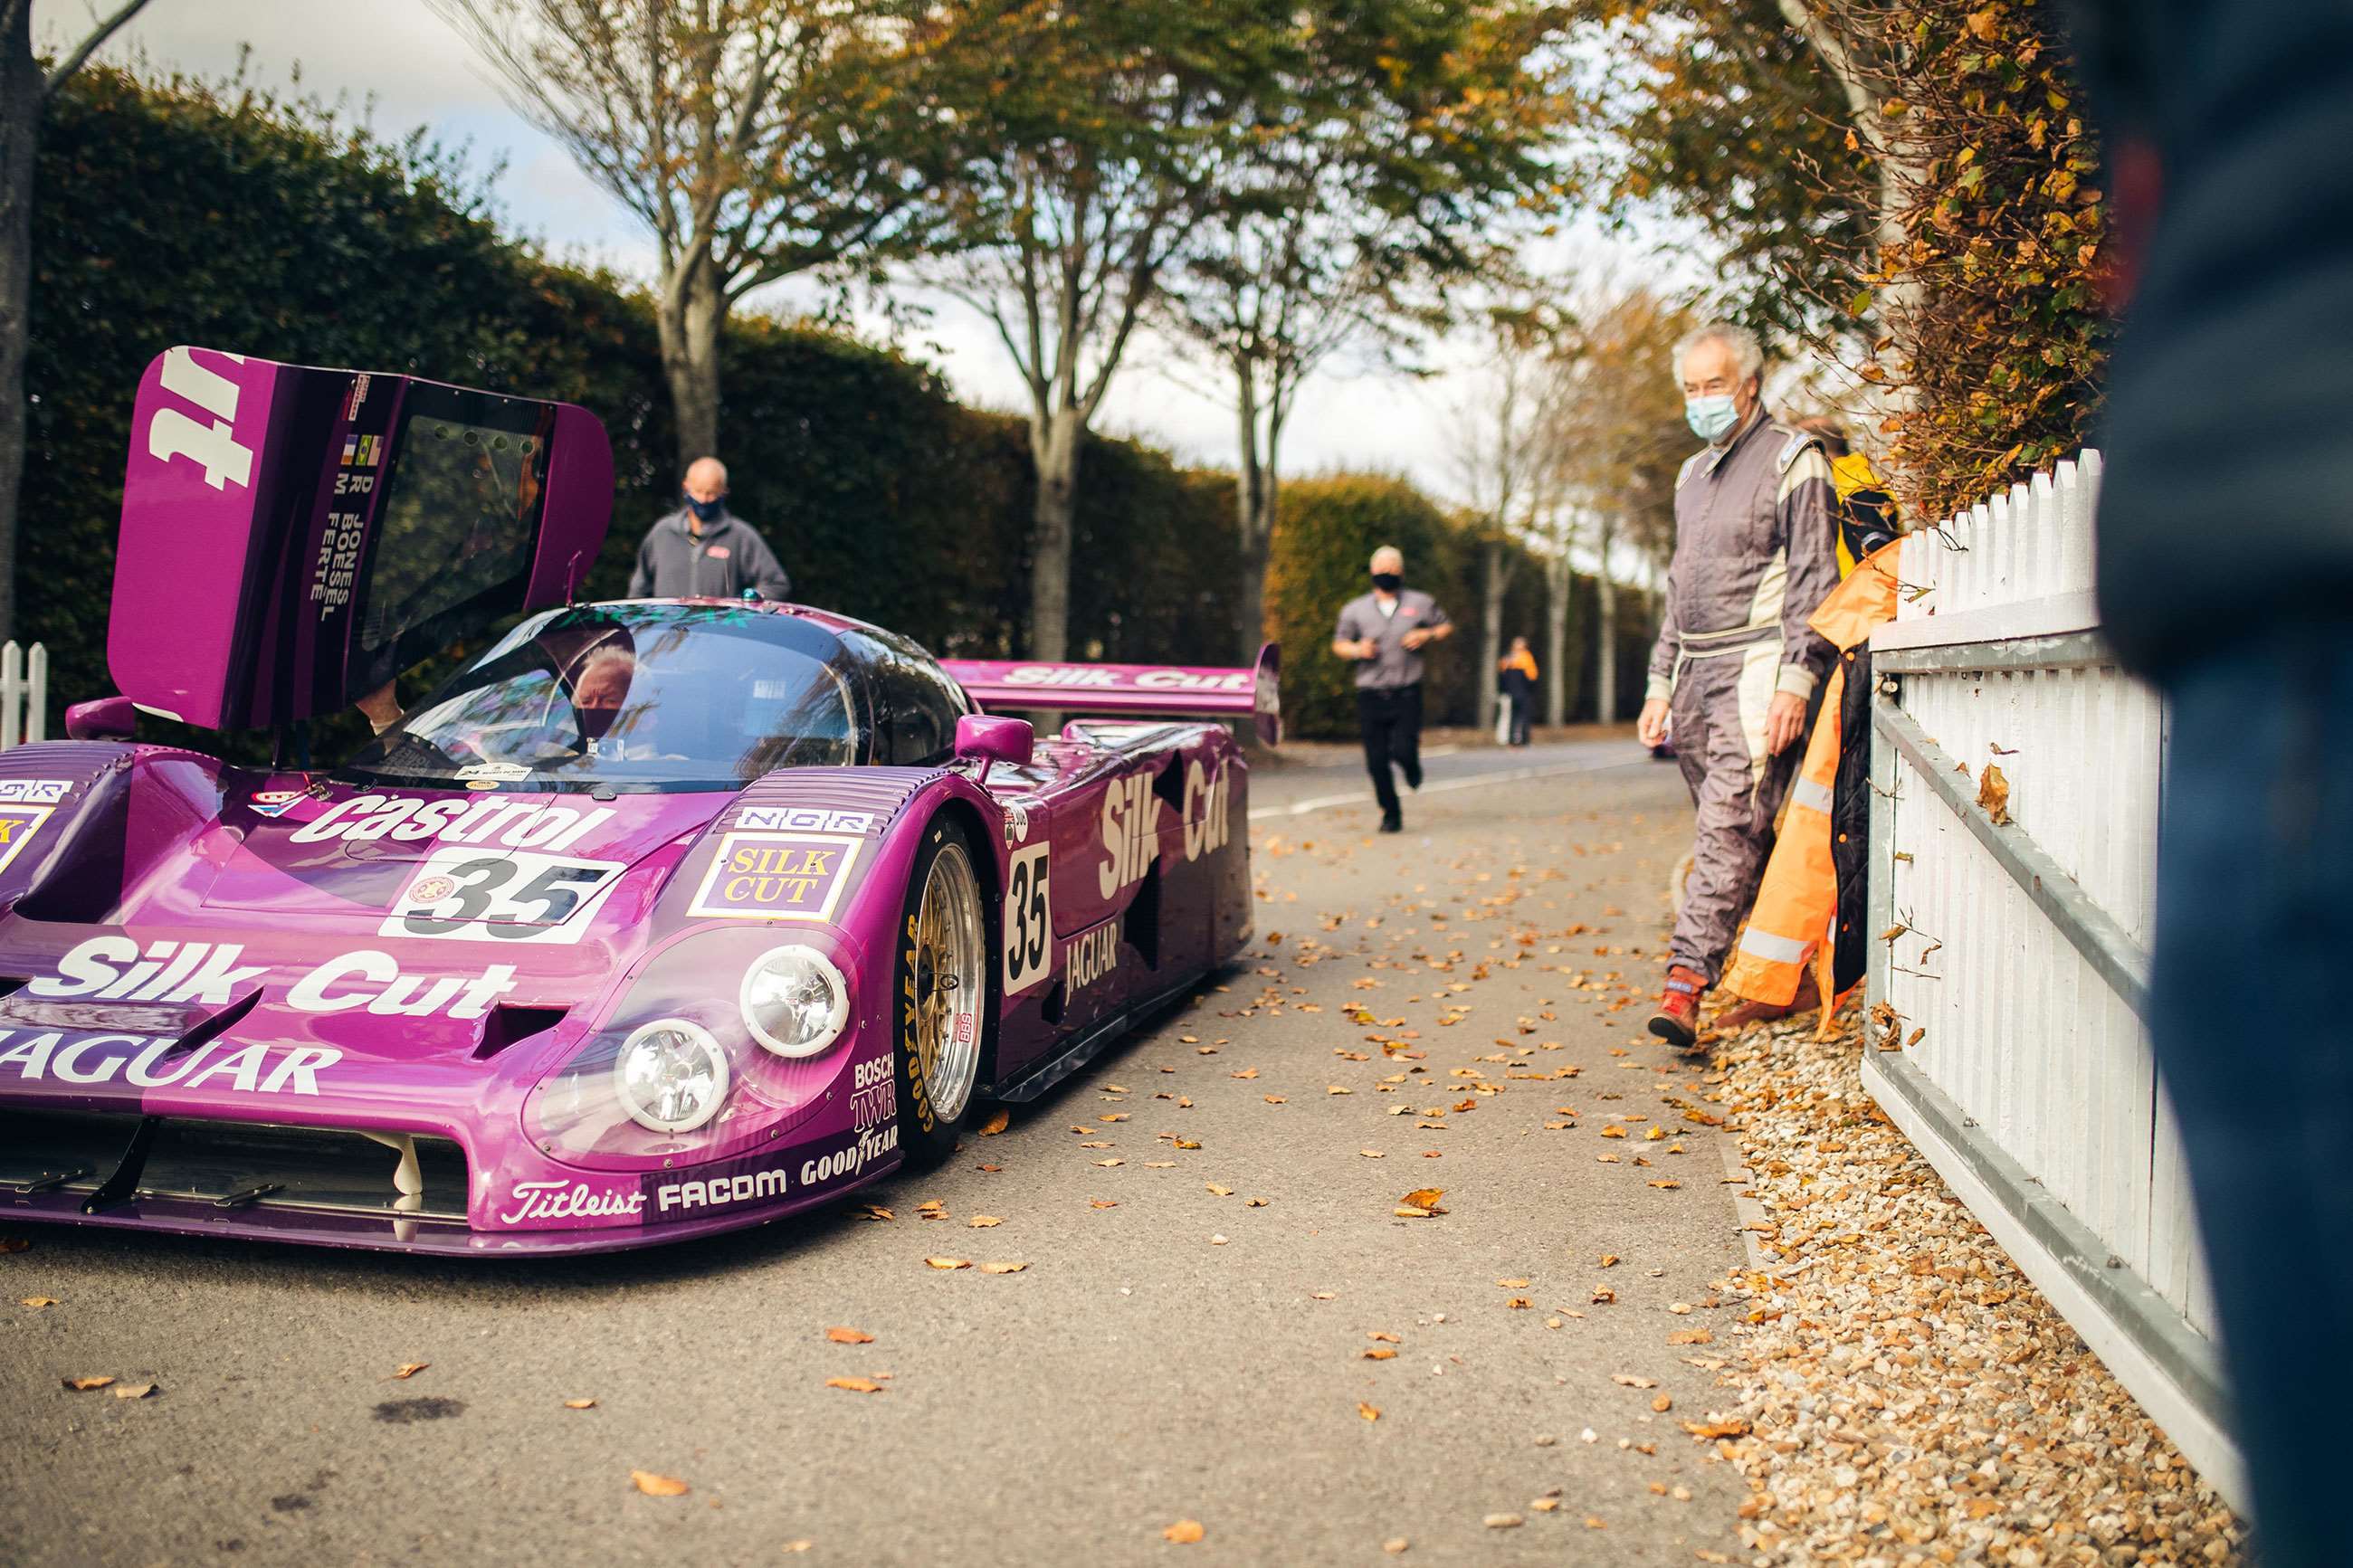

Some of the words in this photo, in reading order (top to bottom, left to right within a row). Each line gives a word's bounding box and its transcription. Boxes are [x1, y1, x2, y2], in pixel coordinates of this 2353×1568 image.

[333, 472, 349, 495] M
[348, 475, 362, 493] R
[361, 476, 375, 493] D
[320, 513, 355, 622] BOESEL
[337, 513, 364, 605] JONES
[1003, 666, 1121, 687] Silk
[1134, 670, 1251, 690] Cut
[290, 794, 619, 851] Castrol
[1099, 771, 1164, 901] Silk
[1183, 758, 1230, 862] Cut
[727, 847, 837, 876] SILK
[405, 858, 604, 939] 35
[724, 876, 820, 904] CUT
[1006, 856, 1051, 983] 35
[29, 936, 271, 1004] Silk
[286, 949, 519, 1020] Cut
[1063, 922, 1119, 1007] JAGUAR
[959, 1013, 972, 1043] BBS
[0, 1031, 343, 1097] AGUAR
[854, 1051, 895, 1090] BOSCH
[850, 1079, 897, 1134] TWR
[800, 1125, 899, 1186] GOODYEAR
[500, 1179, 648, 1224] Titleist
[658, 1169, 787, 1212] FACOM
